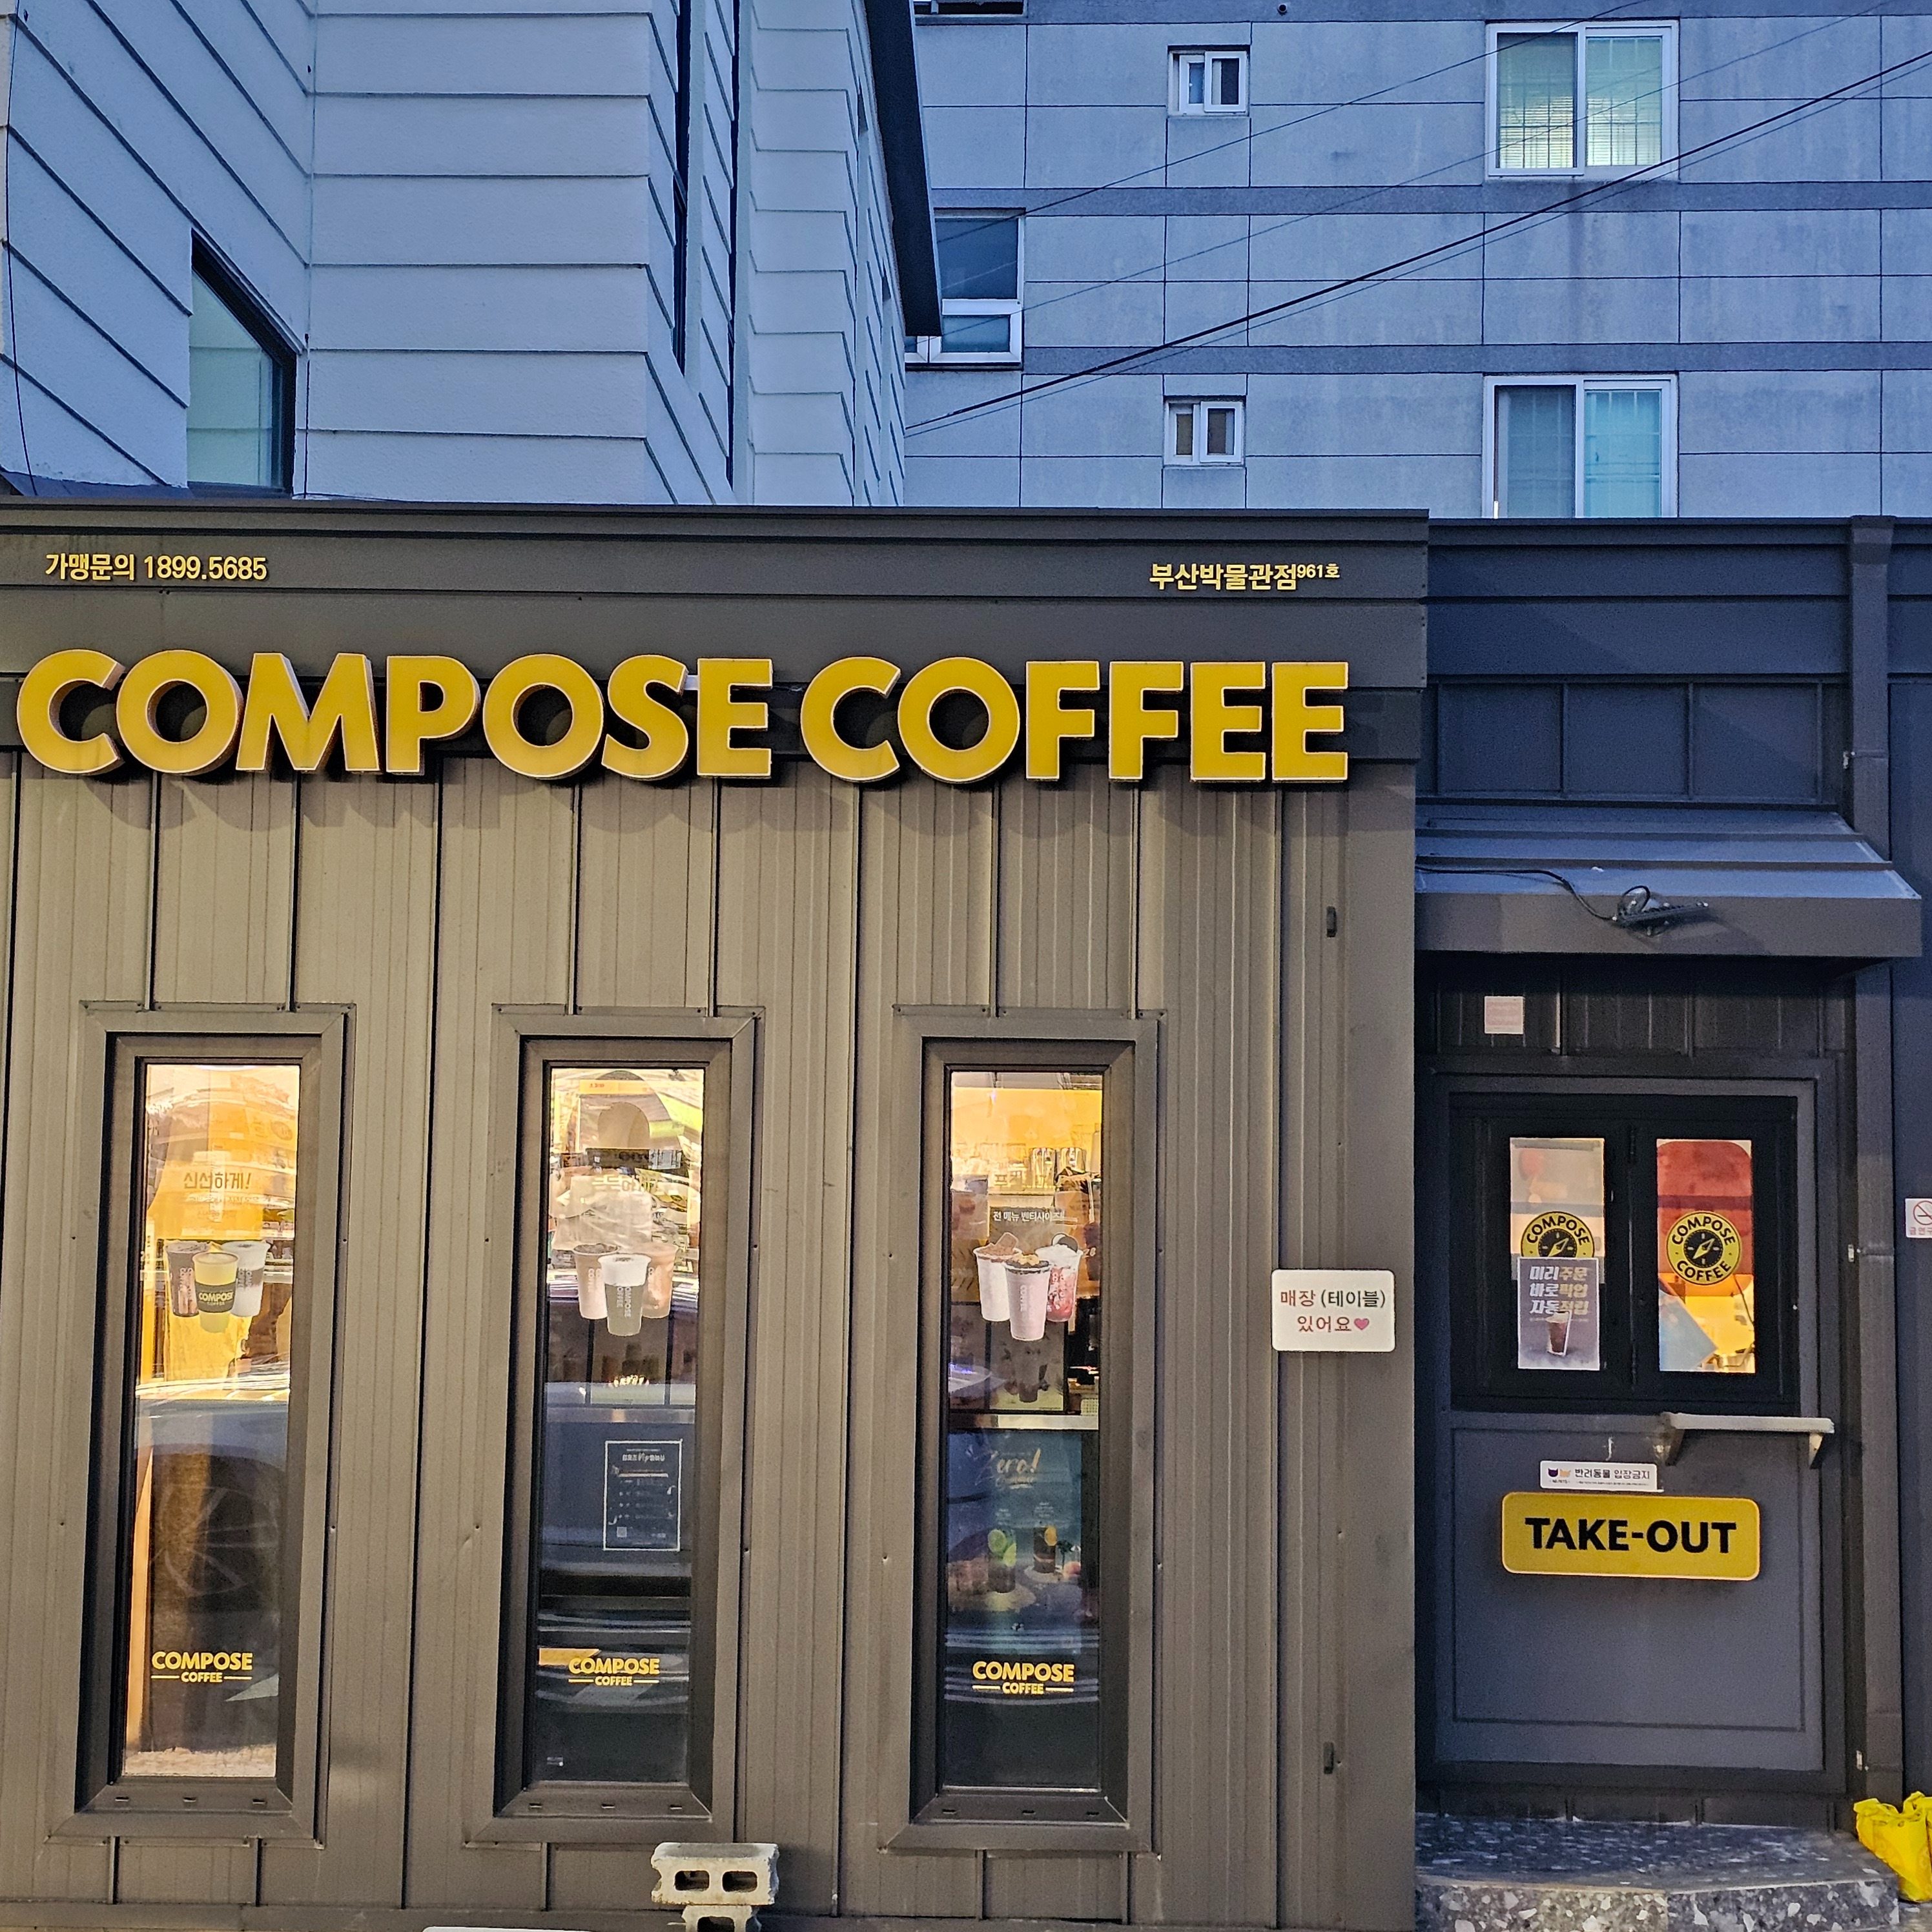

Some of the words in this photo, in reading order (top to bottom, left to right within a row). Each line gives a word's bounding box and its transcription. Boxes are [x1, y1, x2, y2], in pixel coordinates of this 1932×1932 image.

[45, 553, 135, 581] 가맹문의
[144, 554, 267, 581] 1899.5685
[17, 649, 773, 780] COMPOSE
[800, 655, 1350, 783] COFFEE
[183, 1171, 252, 1189] 신선하게!
[992, 1211, 1002, 1222] 전
[1003, 1211, 1020, 1222] 메뉴
[1526, 1215, 1590, 1246] COMPOSE
[1672, 1216, 1736, 1246] COMPOSE
[1677, 1260, 1731, 1281] COFFEE
[1297, 1315, 1351, 1333] 있어요
[1574, 1468, 1611, 1479] 반려동물
[1614, 1470, 1650, 1480] 입장금지
[1525, 1517, 1738, 1554] TAKE-OUT
[151, 1651, 253, 1670] COMPOSE
[568, 1658, 661, 1674] COMPOSE
[180, 1671, 223, 1683] COFFEE
[594, 1676, 633, 1686] COFFEE
[972, 1661, 1075, 1683] COMPOSE
[1002, 1682, 1045, 1695] COFFEE
